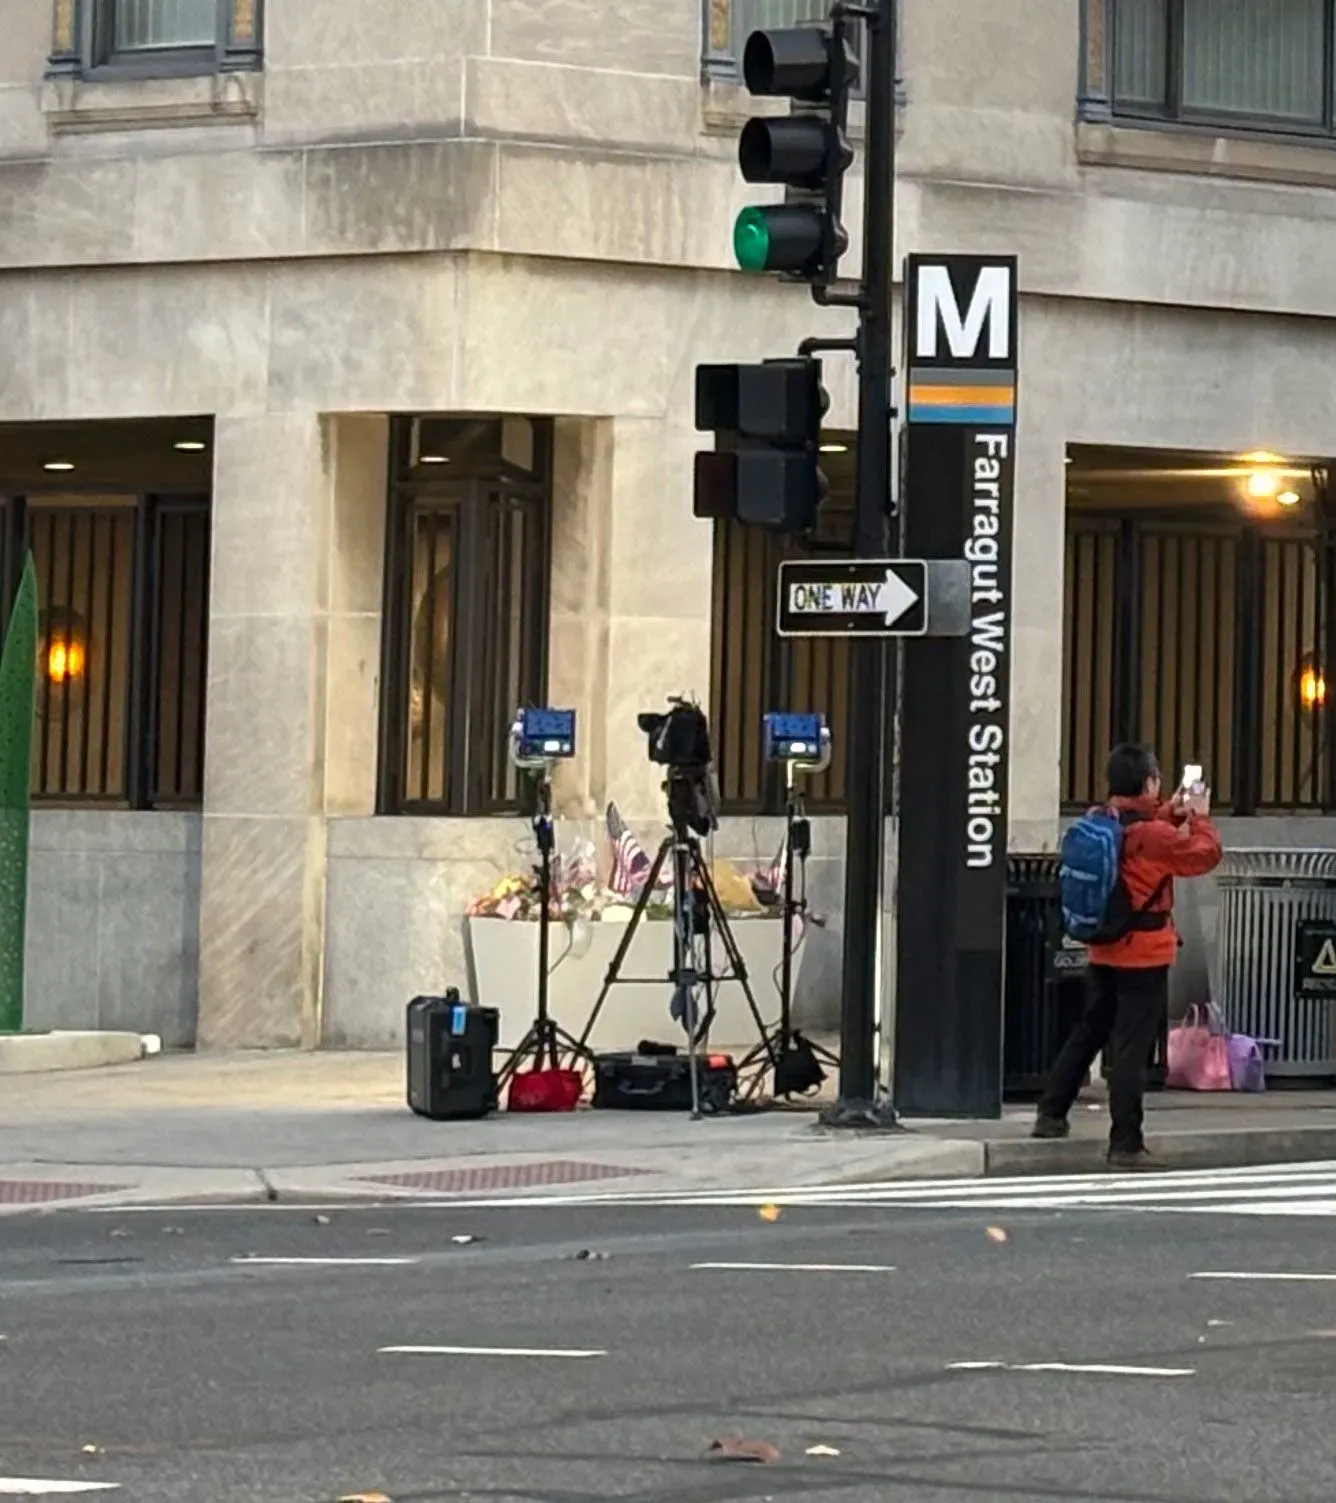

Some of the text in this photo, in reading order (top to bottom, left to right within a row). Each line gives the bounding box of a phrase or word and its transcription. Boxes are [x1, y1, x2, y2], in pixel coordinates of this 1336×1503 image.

[916, 266, 1010, 359] M
[794, 584, 881, 610] ONE WAY
[965, 434, 1008, 867] Farragut West Station
